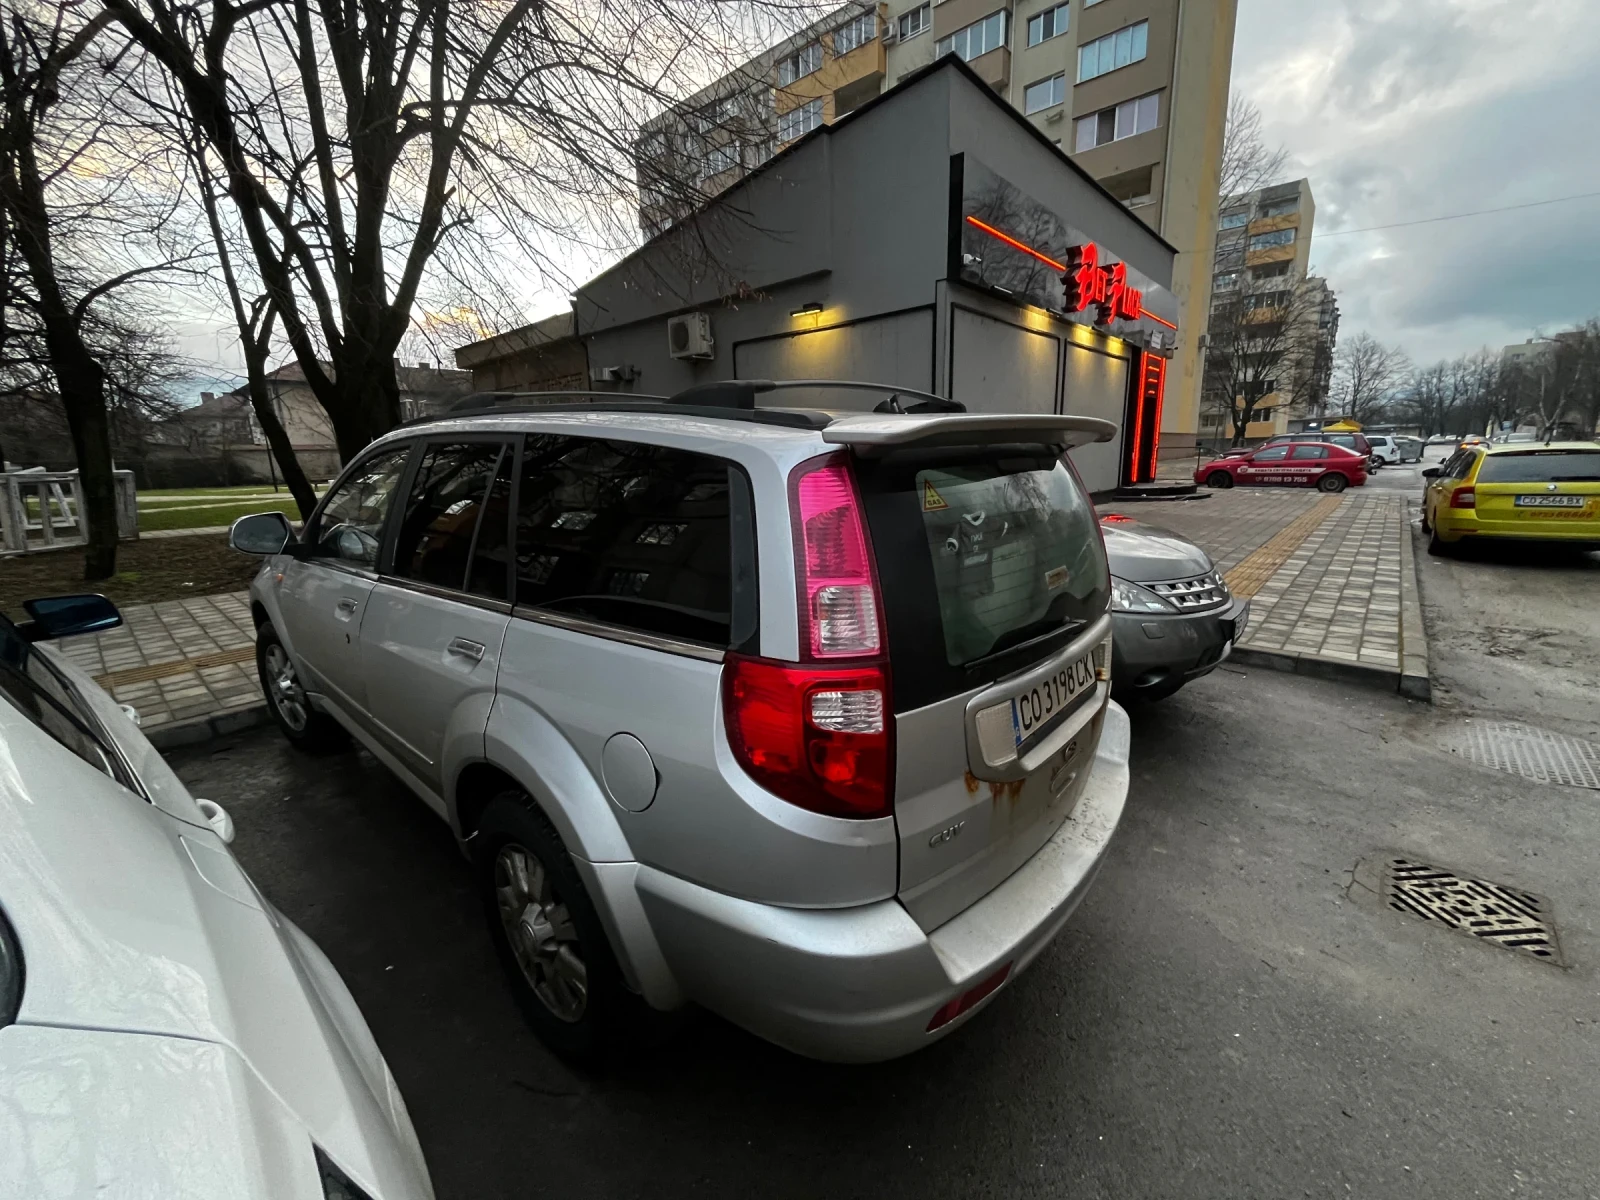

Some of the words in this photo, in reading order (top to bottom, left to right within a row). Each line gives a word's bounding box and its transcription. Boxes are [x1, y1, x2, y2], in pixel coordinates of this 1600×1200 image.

[927, 498, 942, 506] GAS
[1538, 496, 1565, 504] 2566
[1019, 688, 1042, 731] CO
[1045, 668, 1076, 713] 3198
[1076, 656, 1093, 688] CK
